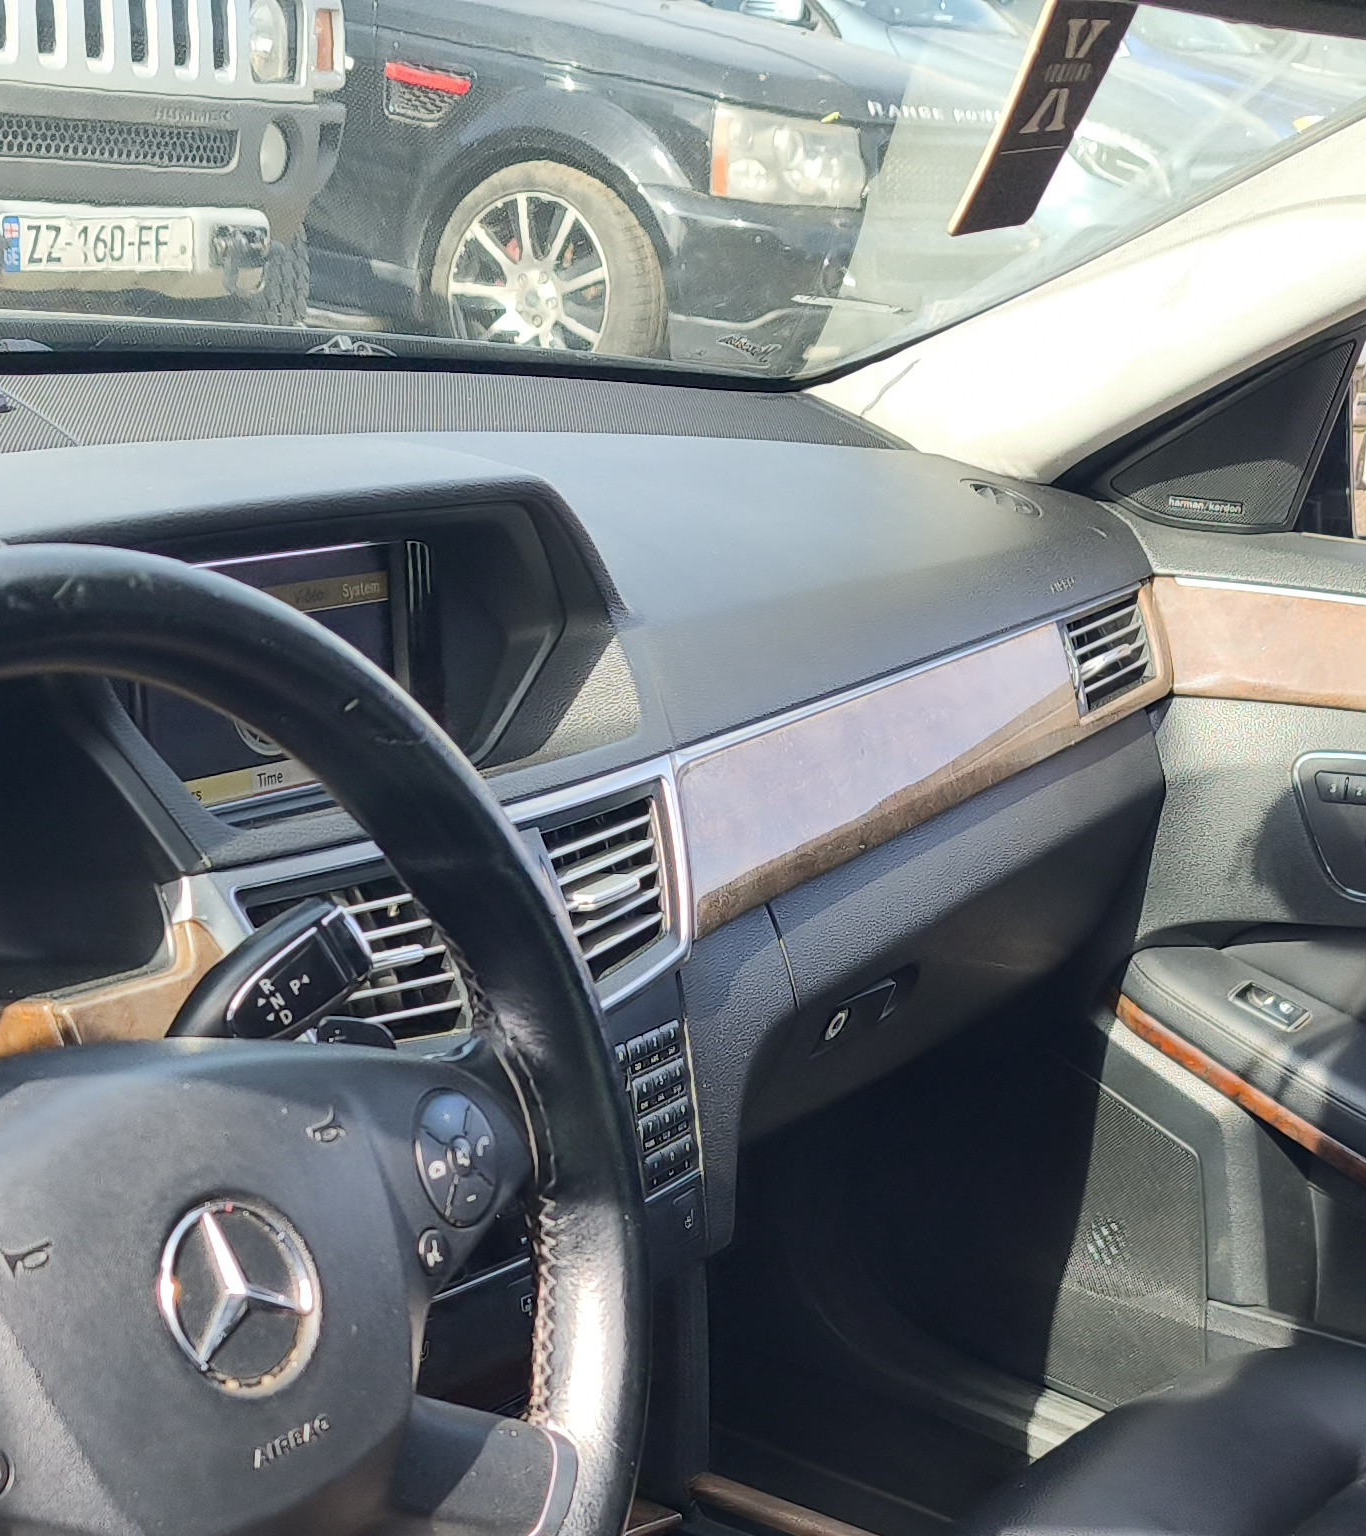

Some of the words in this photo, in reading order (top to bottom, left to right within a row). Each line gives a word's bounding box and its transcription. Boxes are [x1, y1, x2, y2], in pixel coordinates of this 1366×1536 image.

[26, 224, 170, 264] ZZ-160-FF
[341, 581, 381, 600] System
[257, 772, 284, 789] Time
[1356, 785, 1363, 796] 2
[258, 978, 276, 995] R
[289, 979, 301, 996] P
[268, 991, 286, 1011] N
[278, 1009, 293, 1026] D
[253, 1412, 331, 1470] AIRBAG
